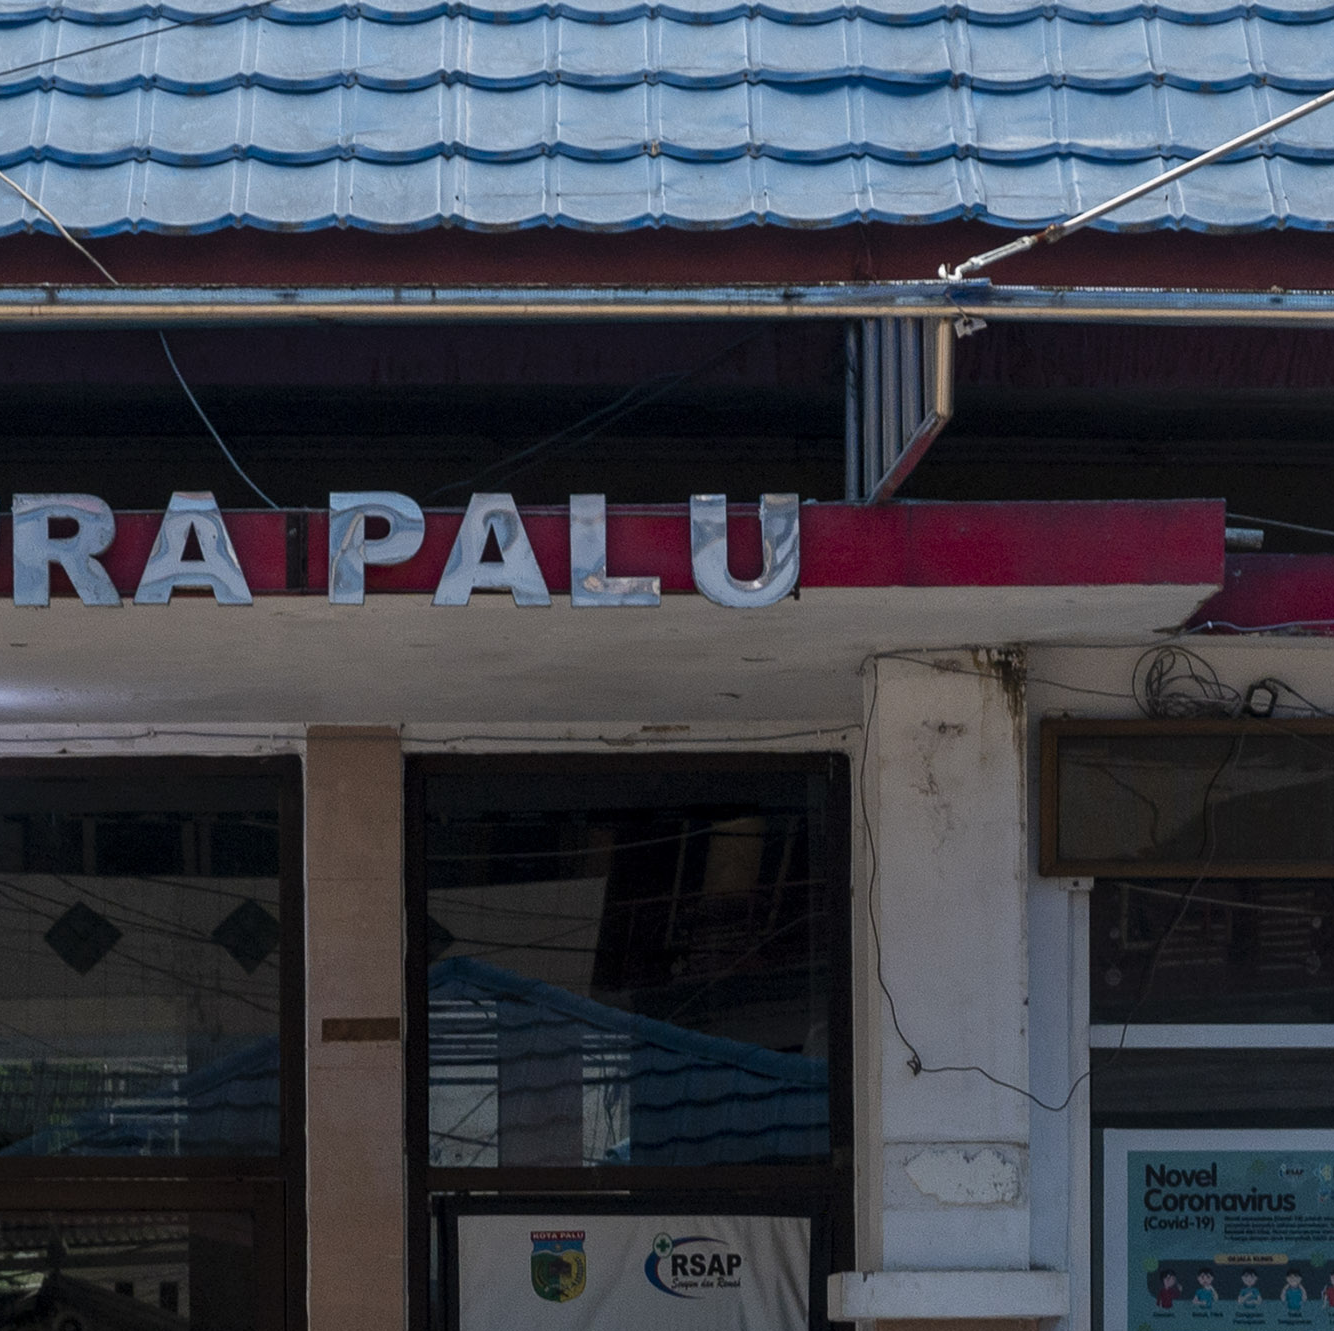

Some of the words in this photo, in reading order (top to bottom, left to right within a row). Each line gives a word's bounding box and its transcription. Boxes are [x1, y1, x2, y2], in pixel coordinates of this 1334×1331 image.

[328, 491, 801, 609] PALU
[1145, 1162, 1217, 1187] Novel
[1144, 1187, 1296, 1211] Coronavirus
[1144, 1216, 1215, 1231] (Covid-19)
[671, 1254, 741, 1276] RSAP
